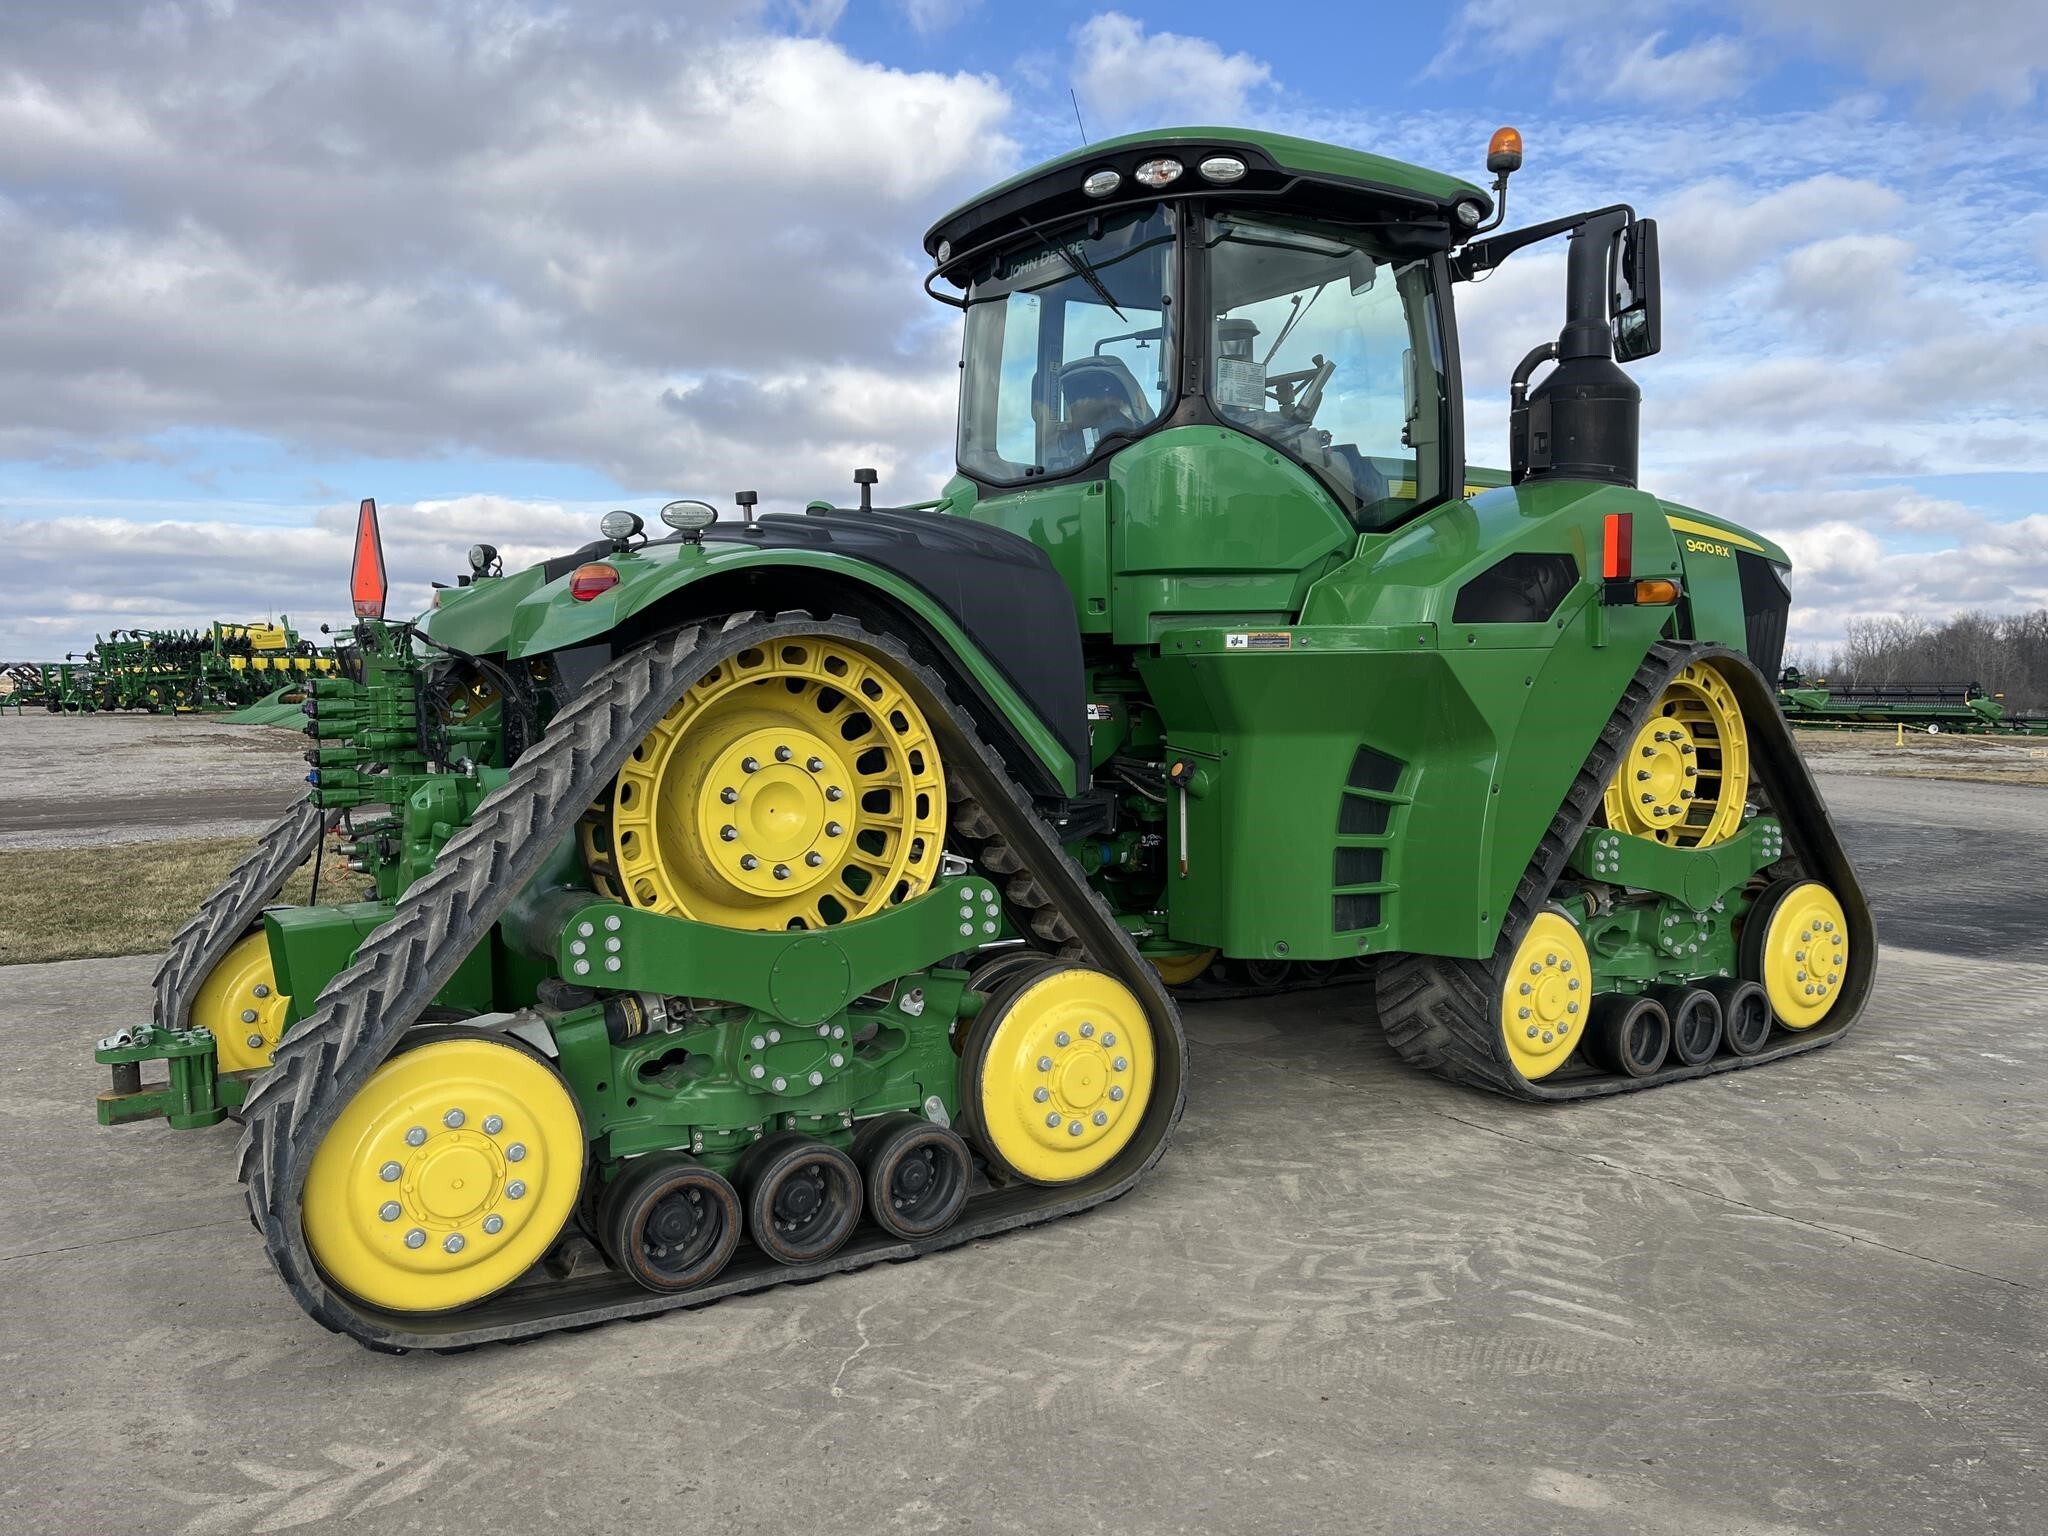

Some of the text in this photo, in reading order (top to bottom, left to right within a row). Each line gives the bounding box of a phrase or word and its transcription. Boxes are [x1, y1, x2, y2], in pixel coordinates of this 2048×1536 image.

[1006, 256, 1038, 280] JOHN
[1686, 539, 1730, 558] 9470 RX
